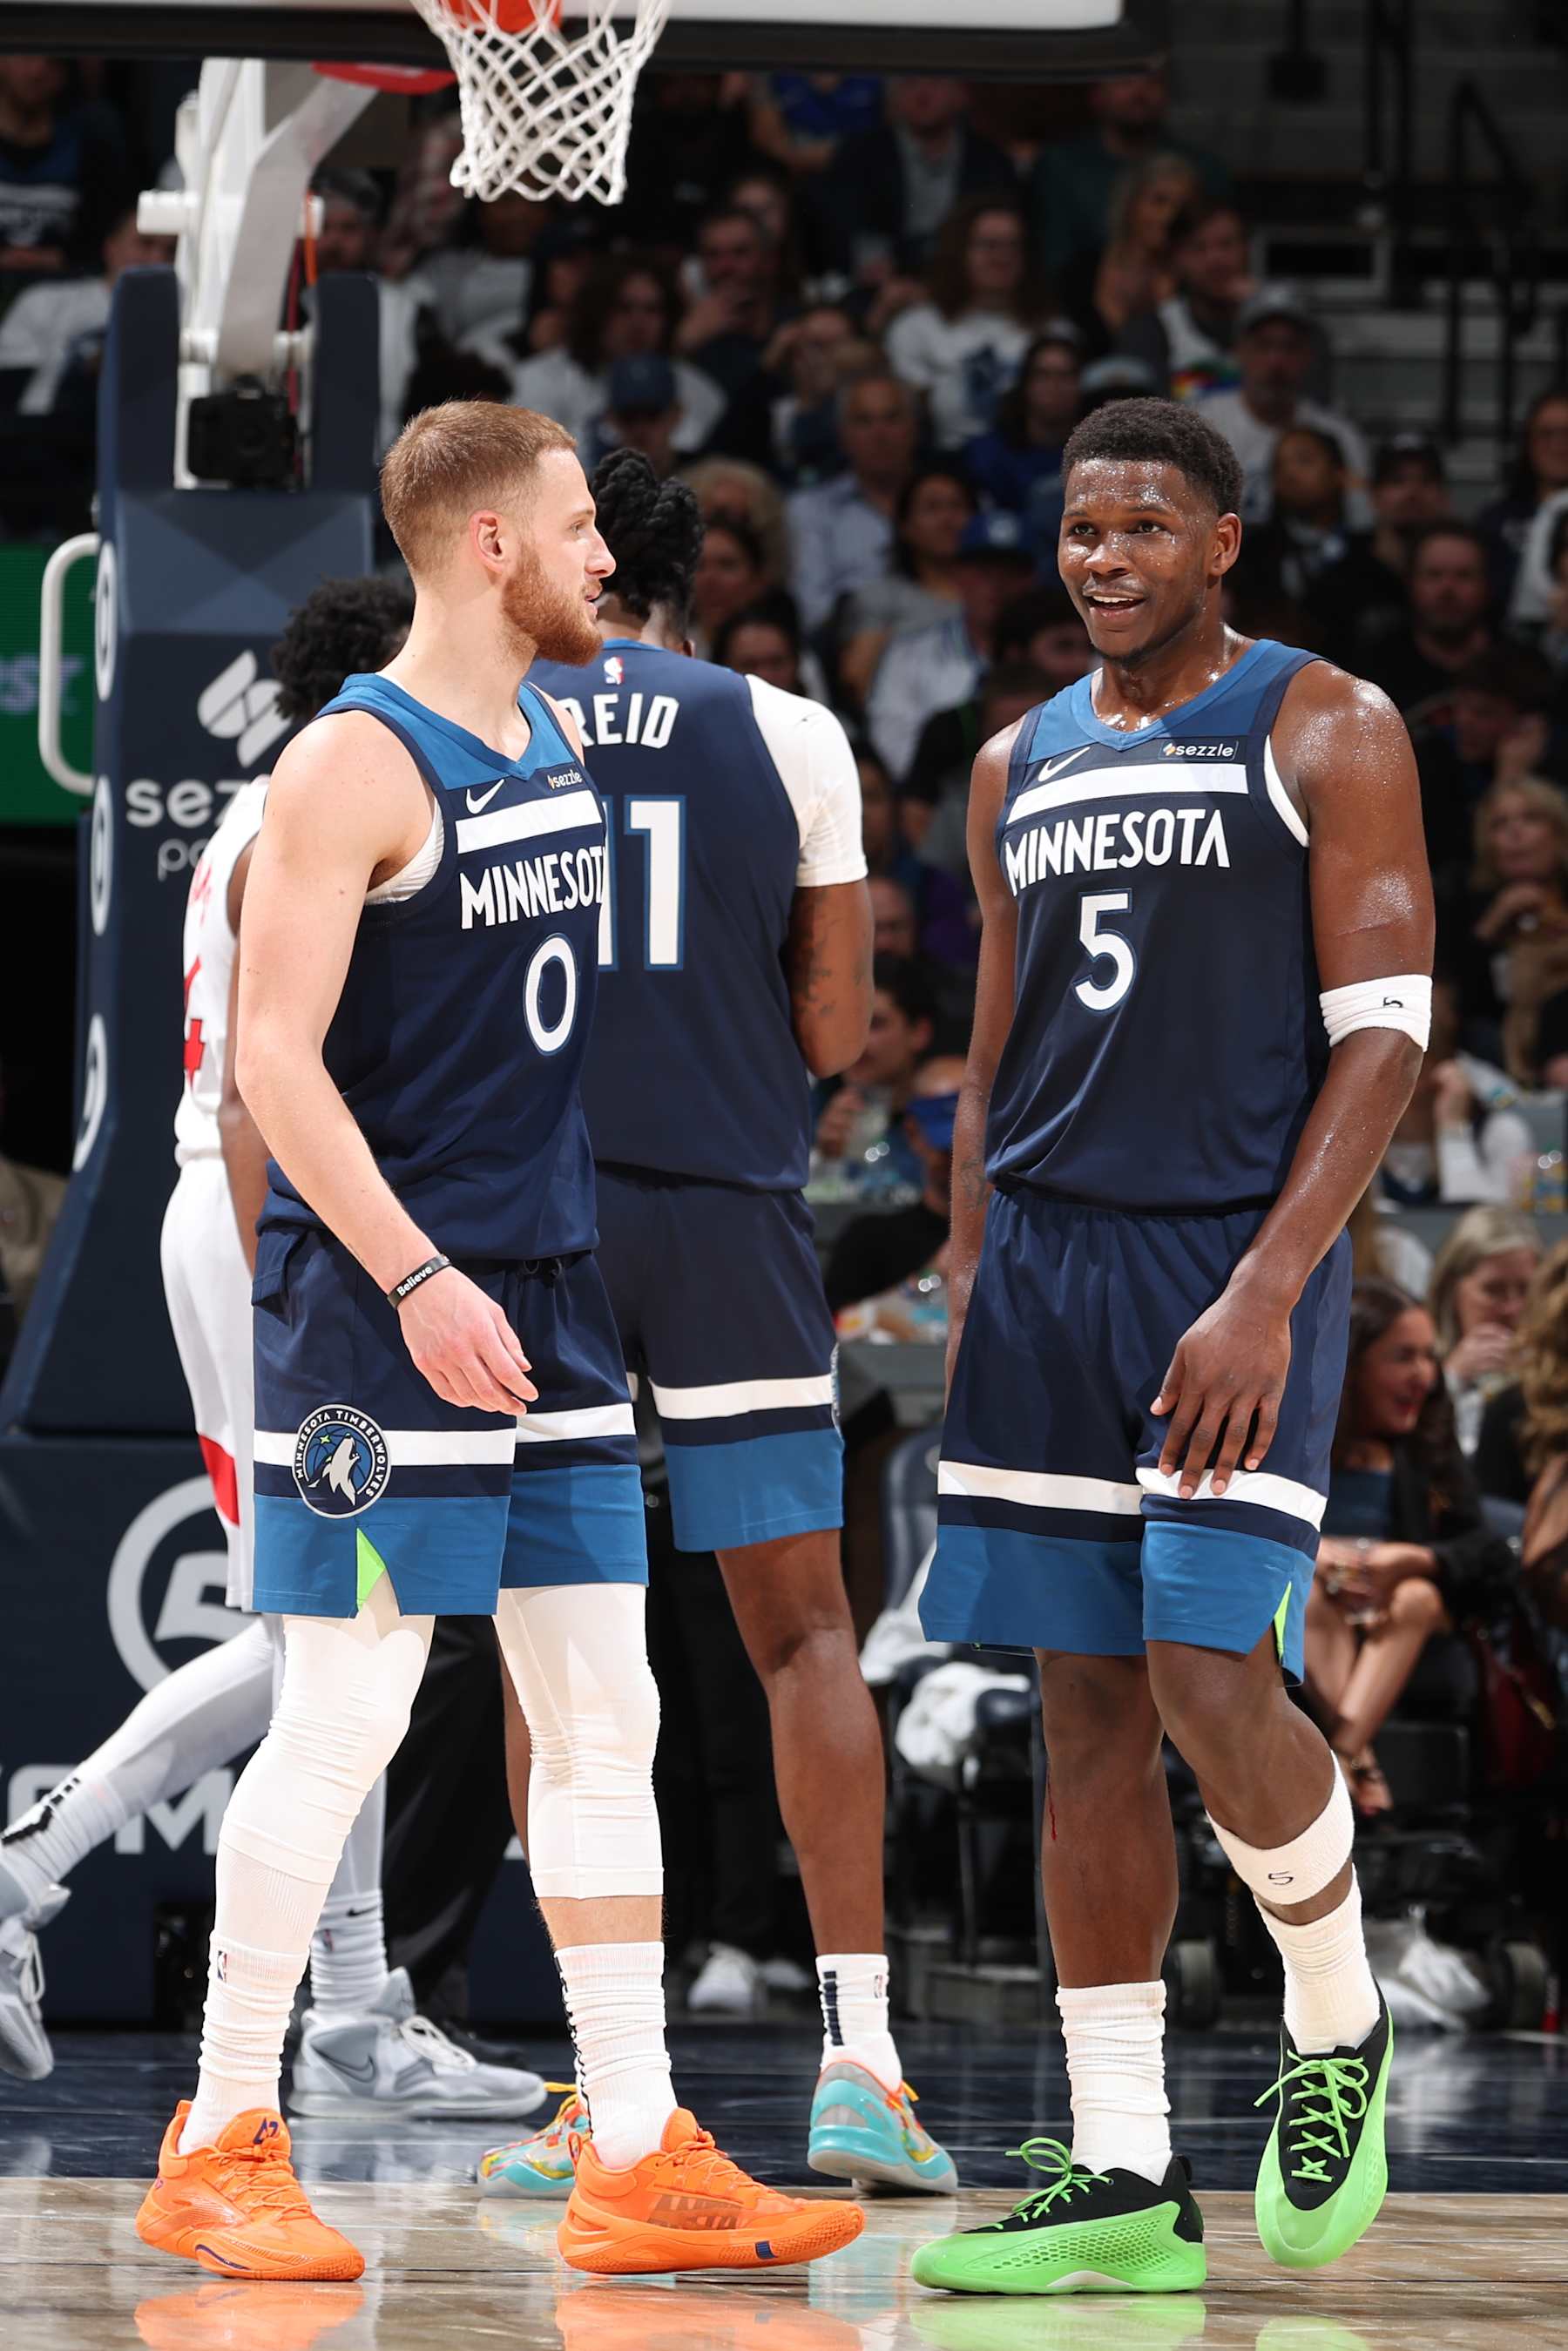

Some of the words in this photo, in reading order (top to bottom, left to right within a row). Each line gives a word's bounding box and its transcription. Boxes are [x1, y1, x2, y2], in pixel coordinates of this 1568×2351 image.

[552, 768, 582, 788] sezzle
[1175, 742, 1233, 757] sezzle
[460, 846, 606, 930] MINNESOT
[1005, 808, 1230, 897] MINNESOTA
[1073, 888, 1137, 1014] 5
[524, 932, 578, 1056] 0
[396, 1267, 433, 1296] Believe
[296, 1412, 330, 1479] MINNESOTA
[336, 1410, 386, 1497] TIMBERWOLVES
